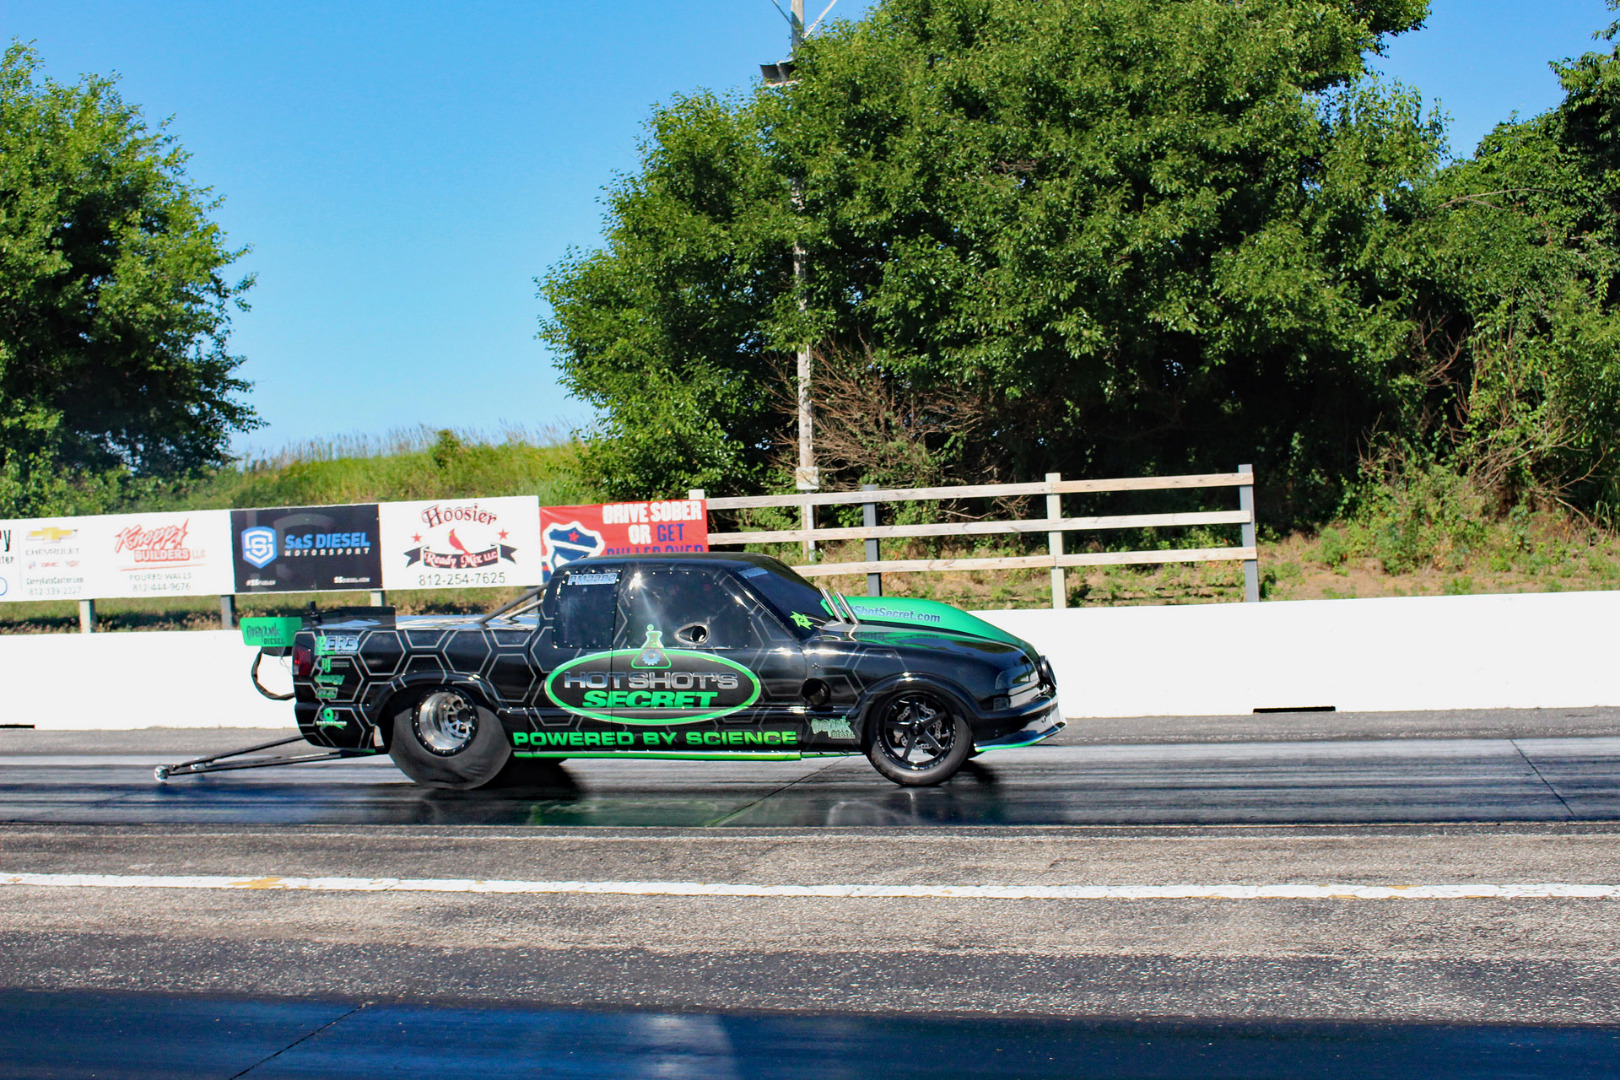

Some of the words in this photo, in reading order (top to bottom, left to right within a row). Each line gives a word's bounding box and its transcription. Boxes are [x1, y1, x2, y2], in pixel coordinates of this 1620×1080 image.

[421, 503, 498, 528] Hoosier
[602, 503, 649, 524] DRIVE
[650, 501, 702, 523] SOBER
[284, 534, 313, 549] S&S
[315, 532, 371, 548] DIESEL
[628, 525, 652, 545] OR
[657, 523, 685, 542] GET
[25, 547, 80, 556] CHEVROLET
[134, 548, 190, 562] BUILDERS
[284, 547, 370, 557] MOTORSPORT
[423, 552, 457, 569] Ready
[460, 554, 482, 568] Mix
[129, 573, 162, 581] POURED
[165, 572, 193, 580] WALLS
[419, 571, 506, 586] 812-254-7625
[263, 637, 285, 645] DIESEL
[582, 690, 719, 709] SECRET
[513, 732, 634, 747] POWERED
[643, 732, 677, 746] BY
[686, 731, 798, 746] SCIENCE
